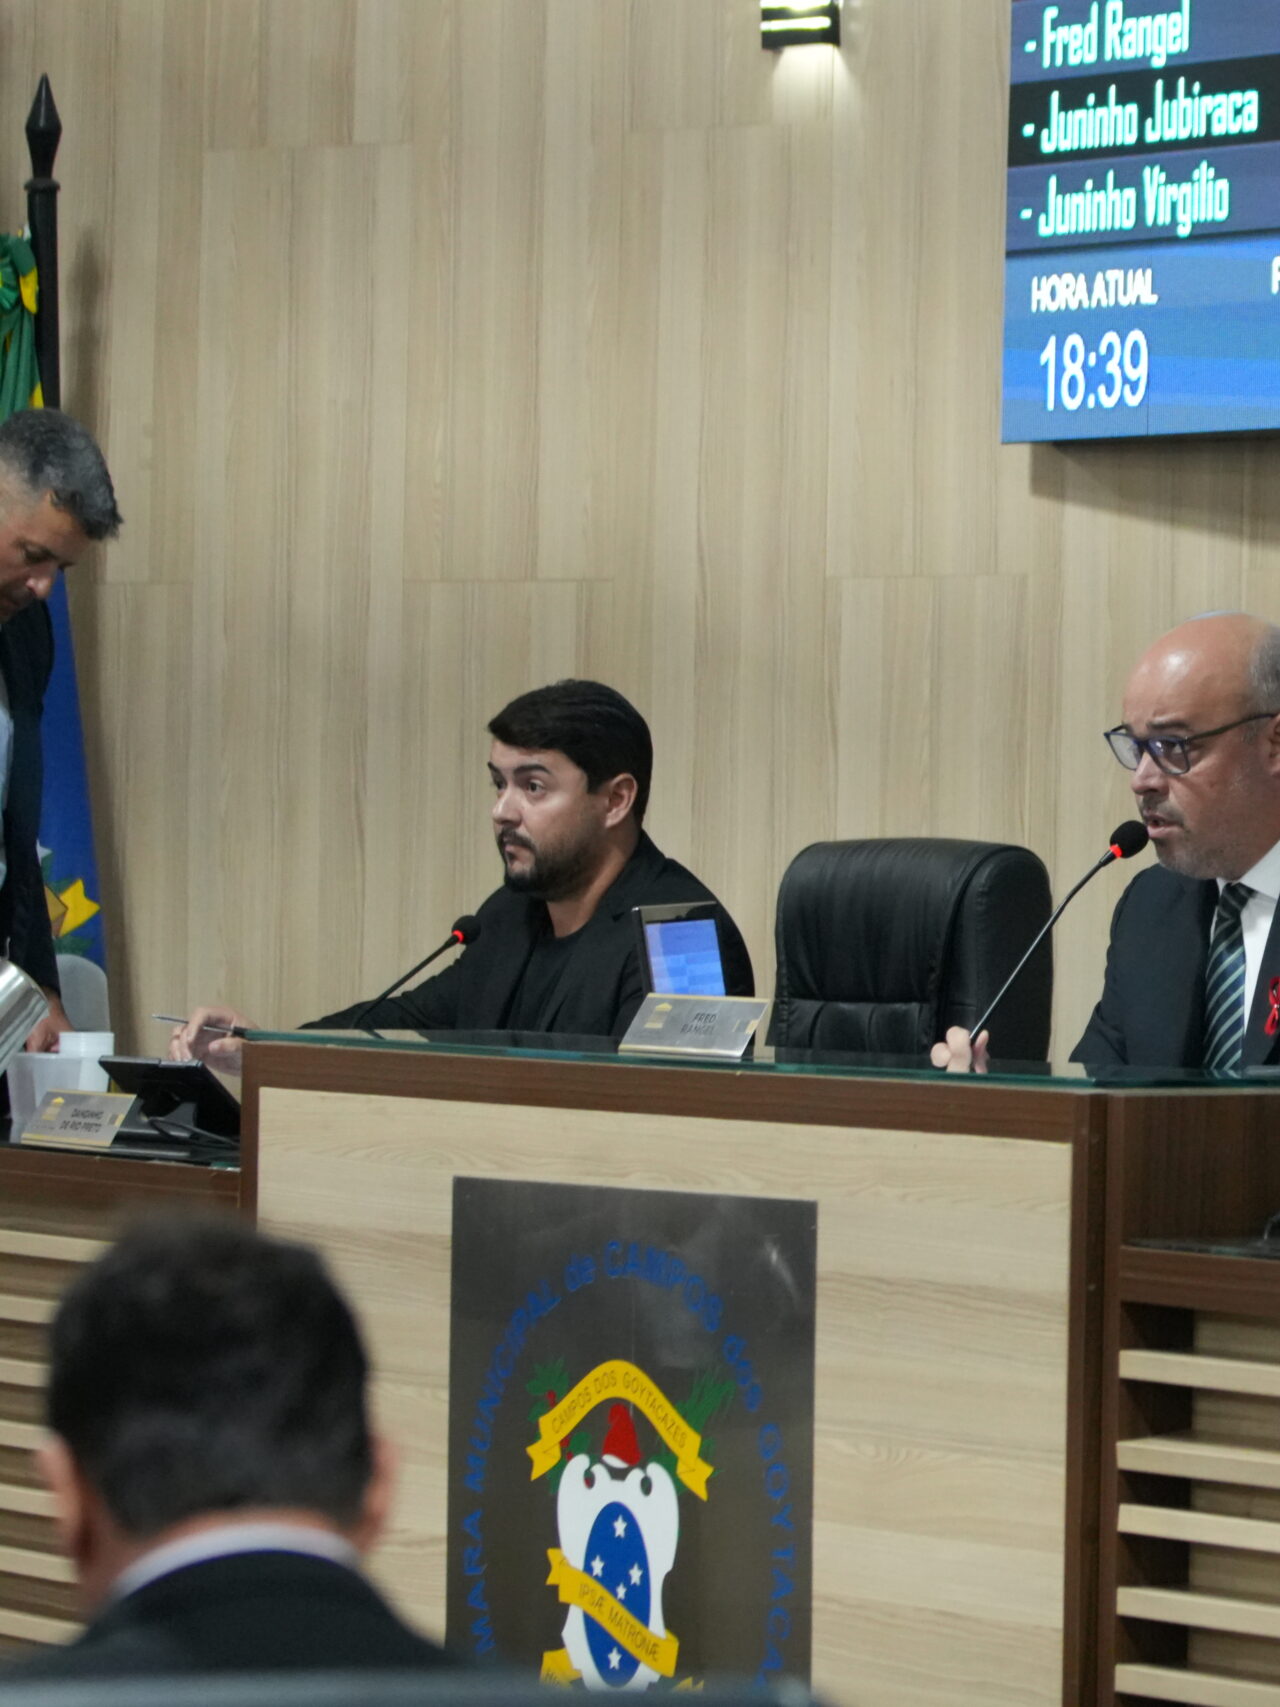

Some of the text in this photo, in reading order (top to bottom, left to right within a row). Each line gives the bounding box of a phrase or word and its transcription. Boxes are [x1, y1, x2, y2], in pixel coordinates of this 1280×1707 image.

[1042, 1, 1099, 69] Fred
[1104, 0, 1190, 69] Rangel
[1040, 84, 1138, 153] Juninho
[1144, 76, 1259, 143] Jubiraca
[1038, 169, 1137, 237] Juninho
[1030, 267, 1159, 314] HORA ATUAL
[1039, 328, 1149, 412] 18:39
[604, 1240, 723, 1332] CAMPOS
[551, 1369, 688, 1449] CAMPOS DOS GOYTACAZES
